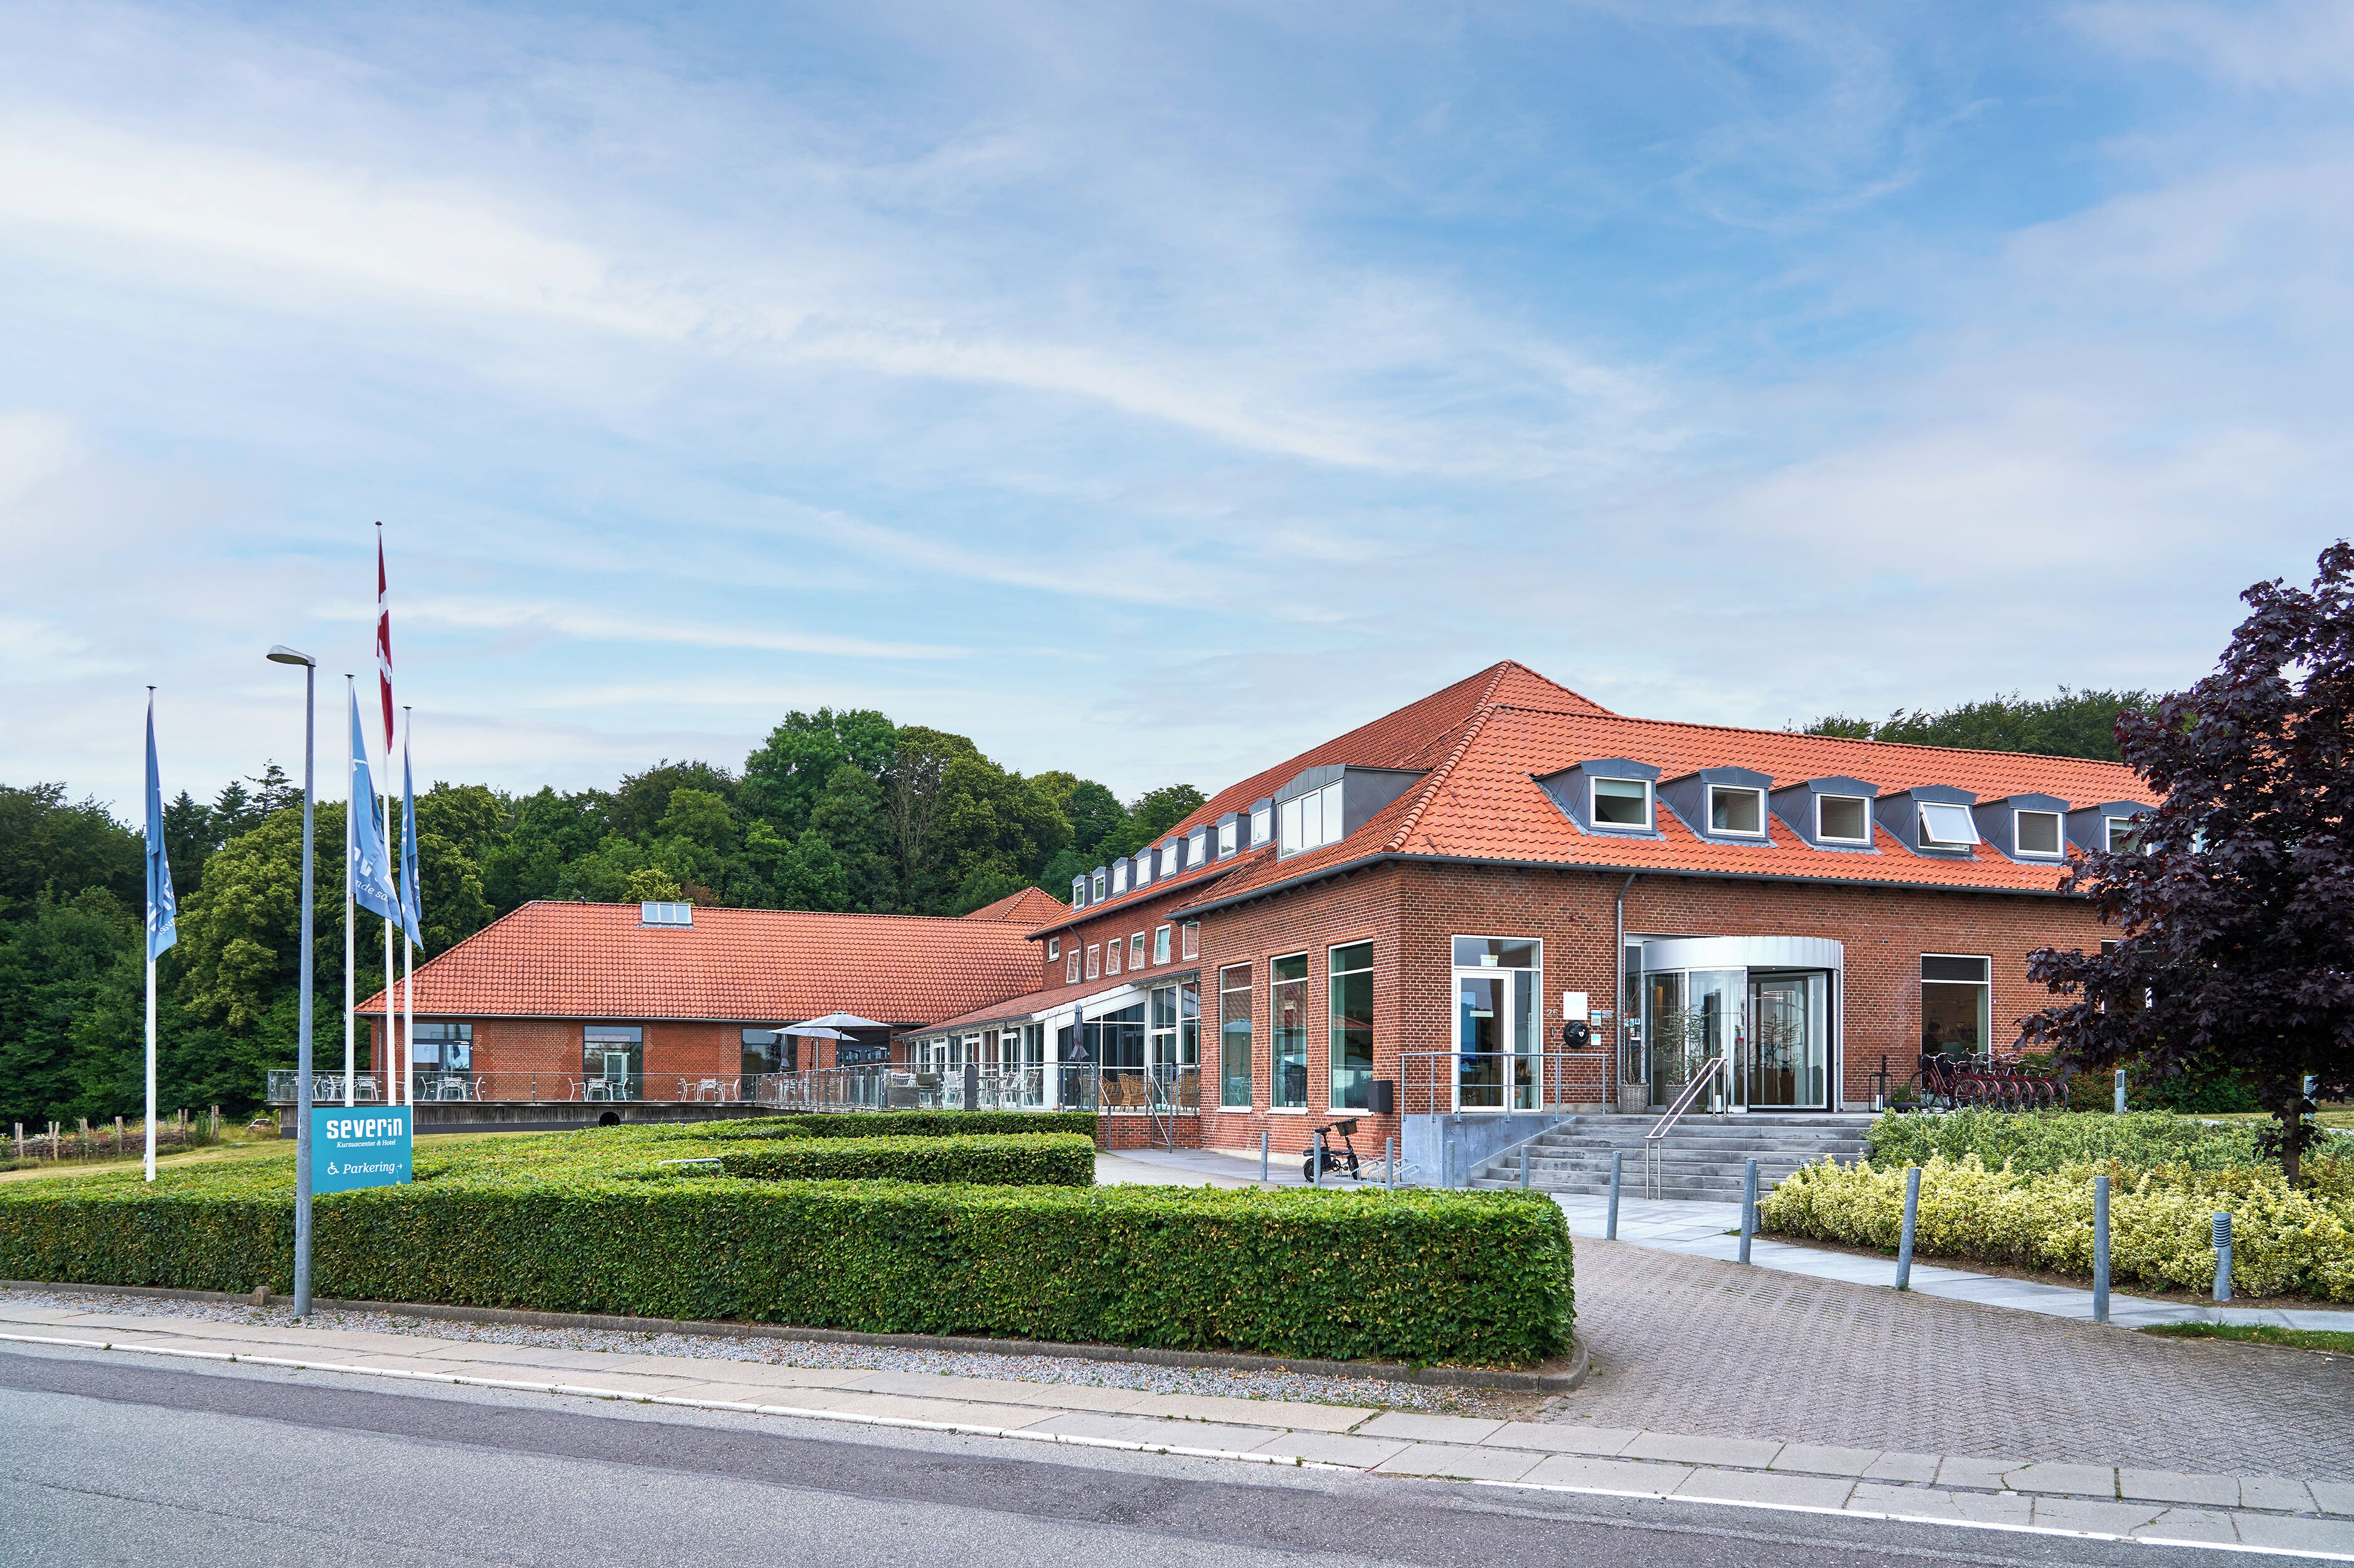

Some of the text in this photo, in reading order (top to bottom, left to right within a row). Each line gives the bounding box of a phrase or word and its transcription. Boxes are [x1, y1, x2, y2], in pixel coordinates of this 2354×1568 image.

[1547, 1009, 1558, 1018] 25
[326, 1118, 402, 1139] severin
[343, 1162, 395, 1174] Parkering
